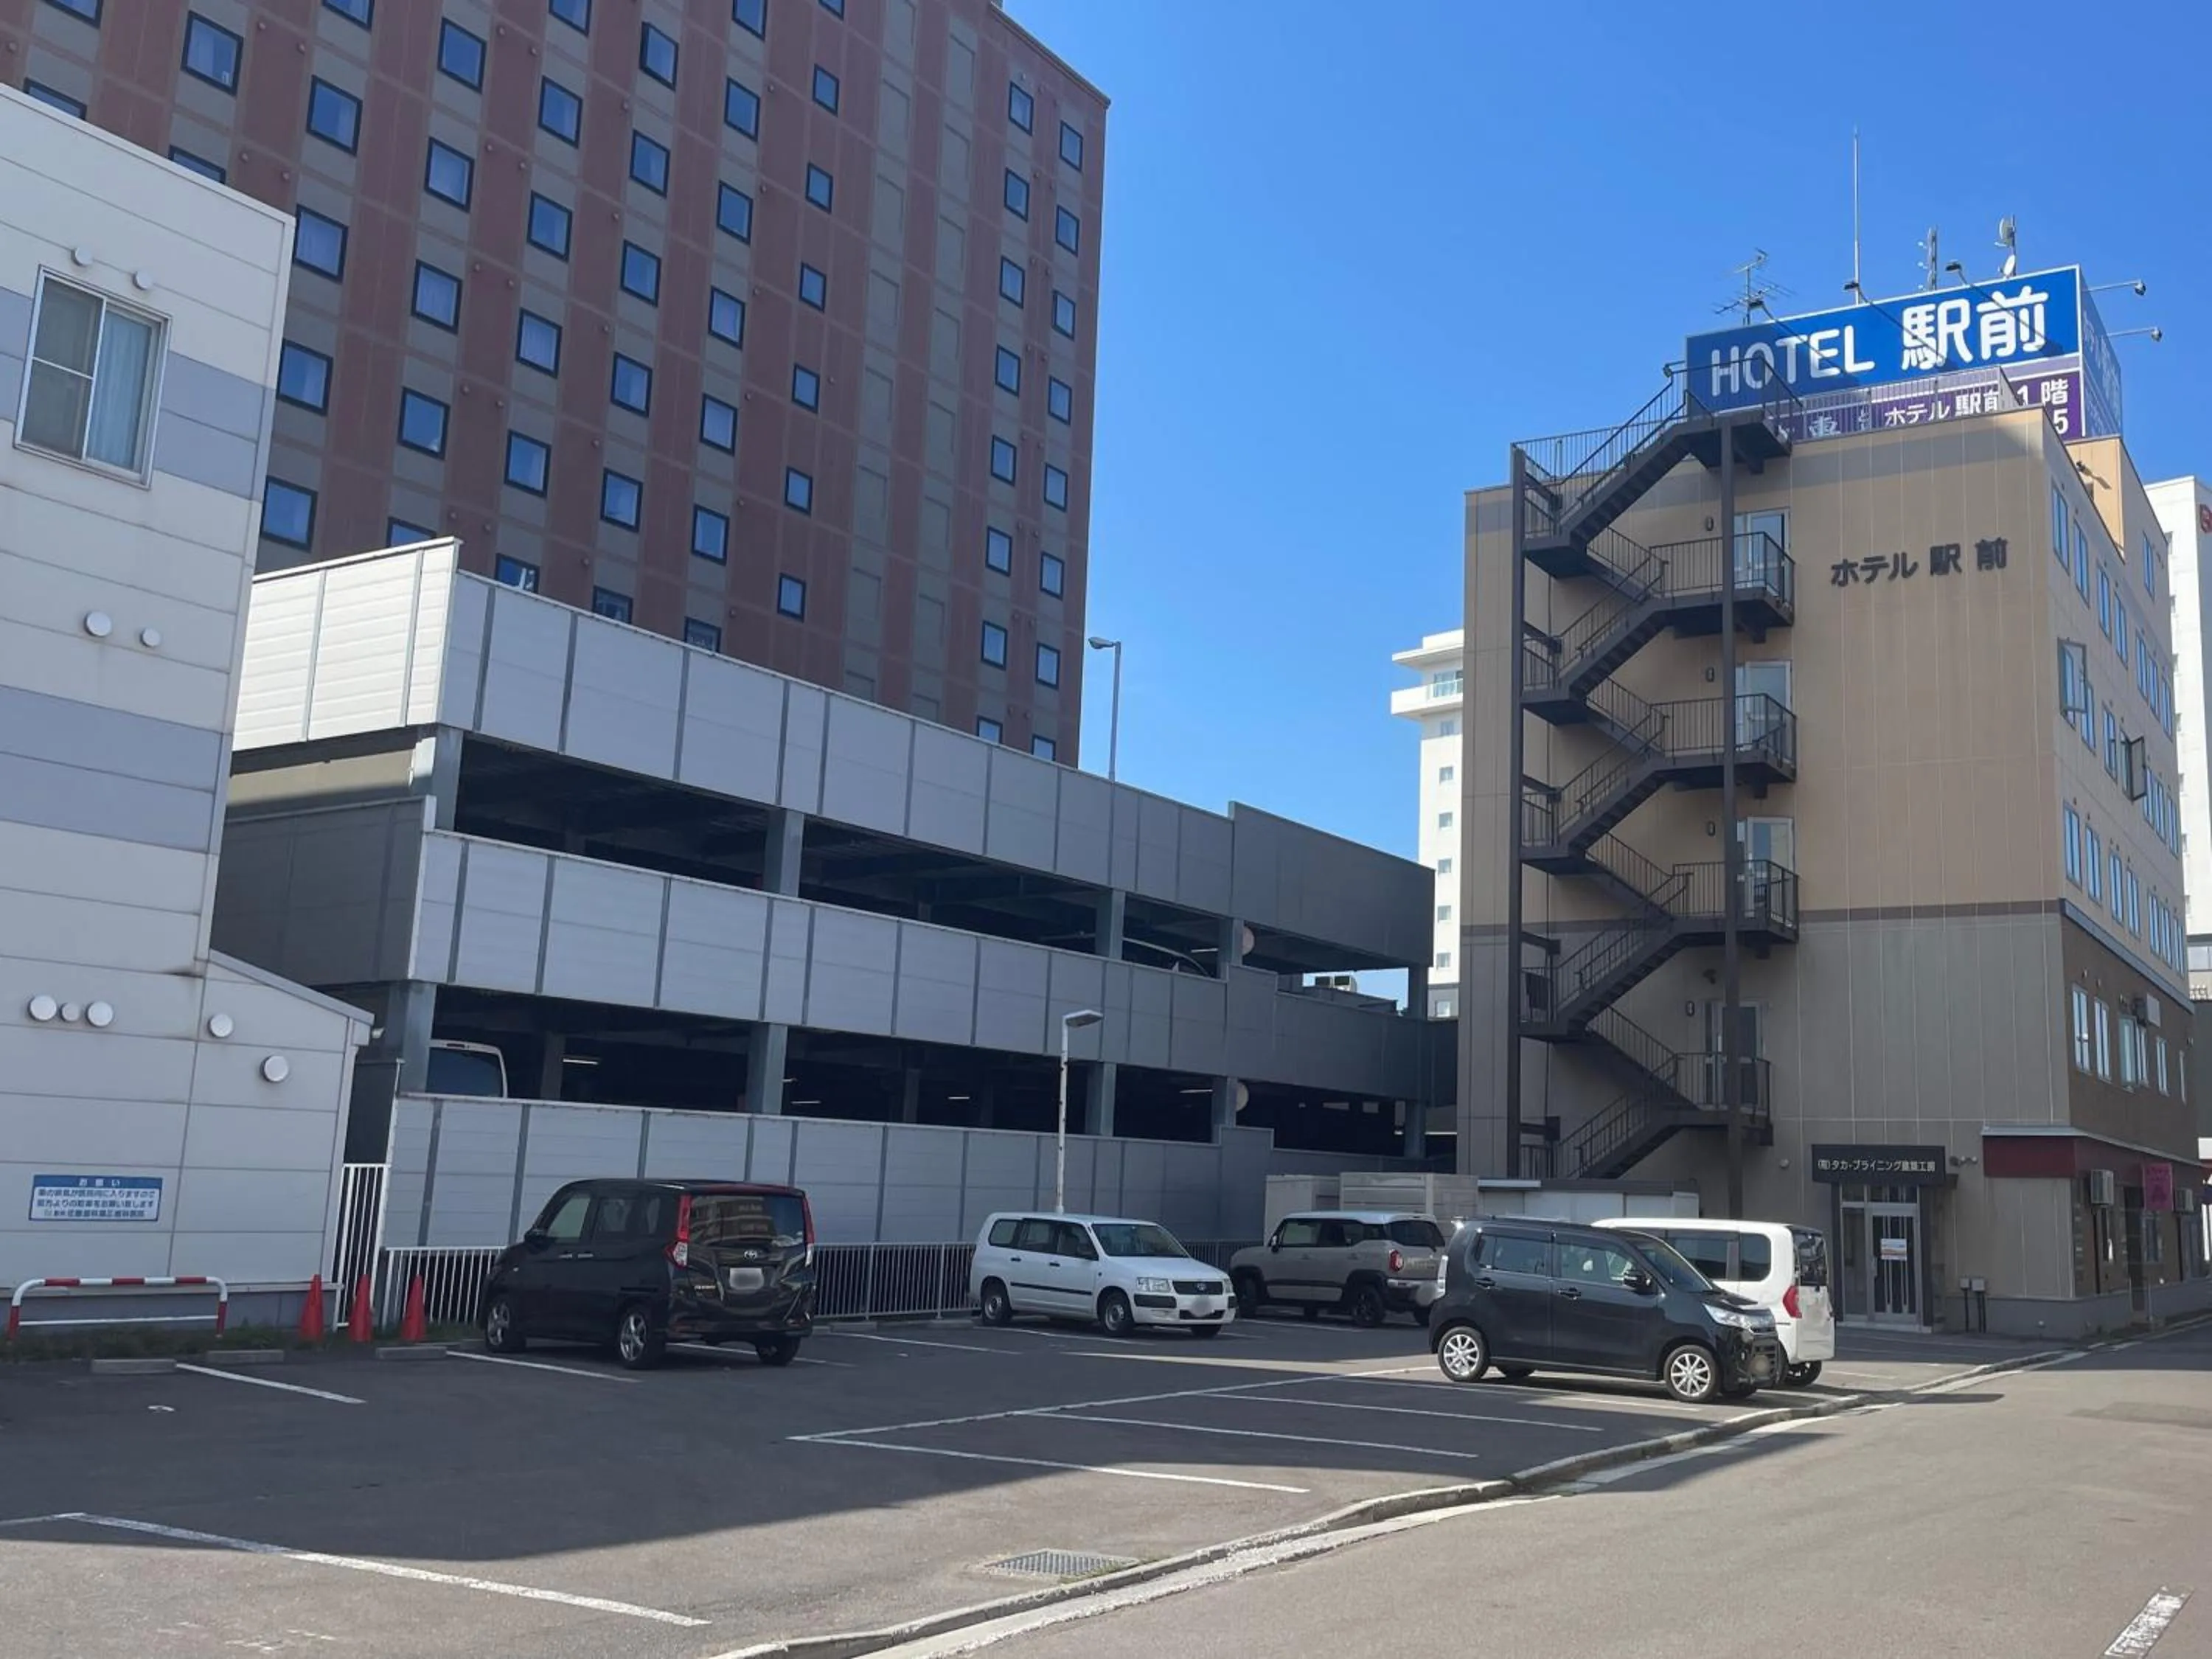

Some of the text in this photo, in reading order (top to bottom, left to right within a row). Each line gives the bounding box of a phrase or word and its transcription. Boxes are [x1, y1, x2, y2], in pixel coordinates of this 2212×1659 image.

[1711, 285, 2048, 397] HOTEL 駅前
[1885, 399, 1950, 426] ホテル
[1831, 536, 2008, 587] ホテル 駅前
